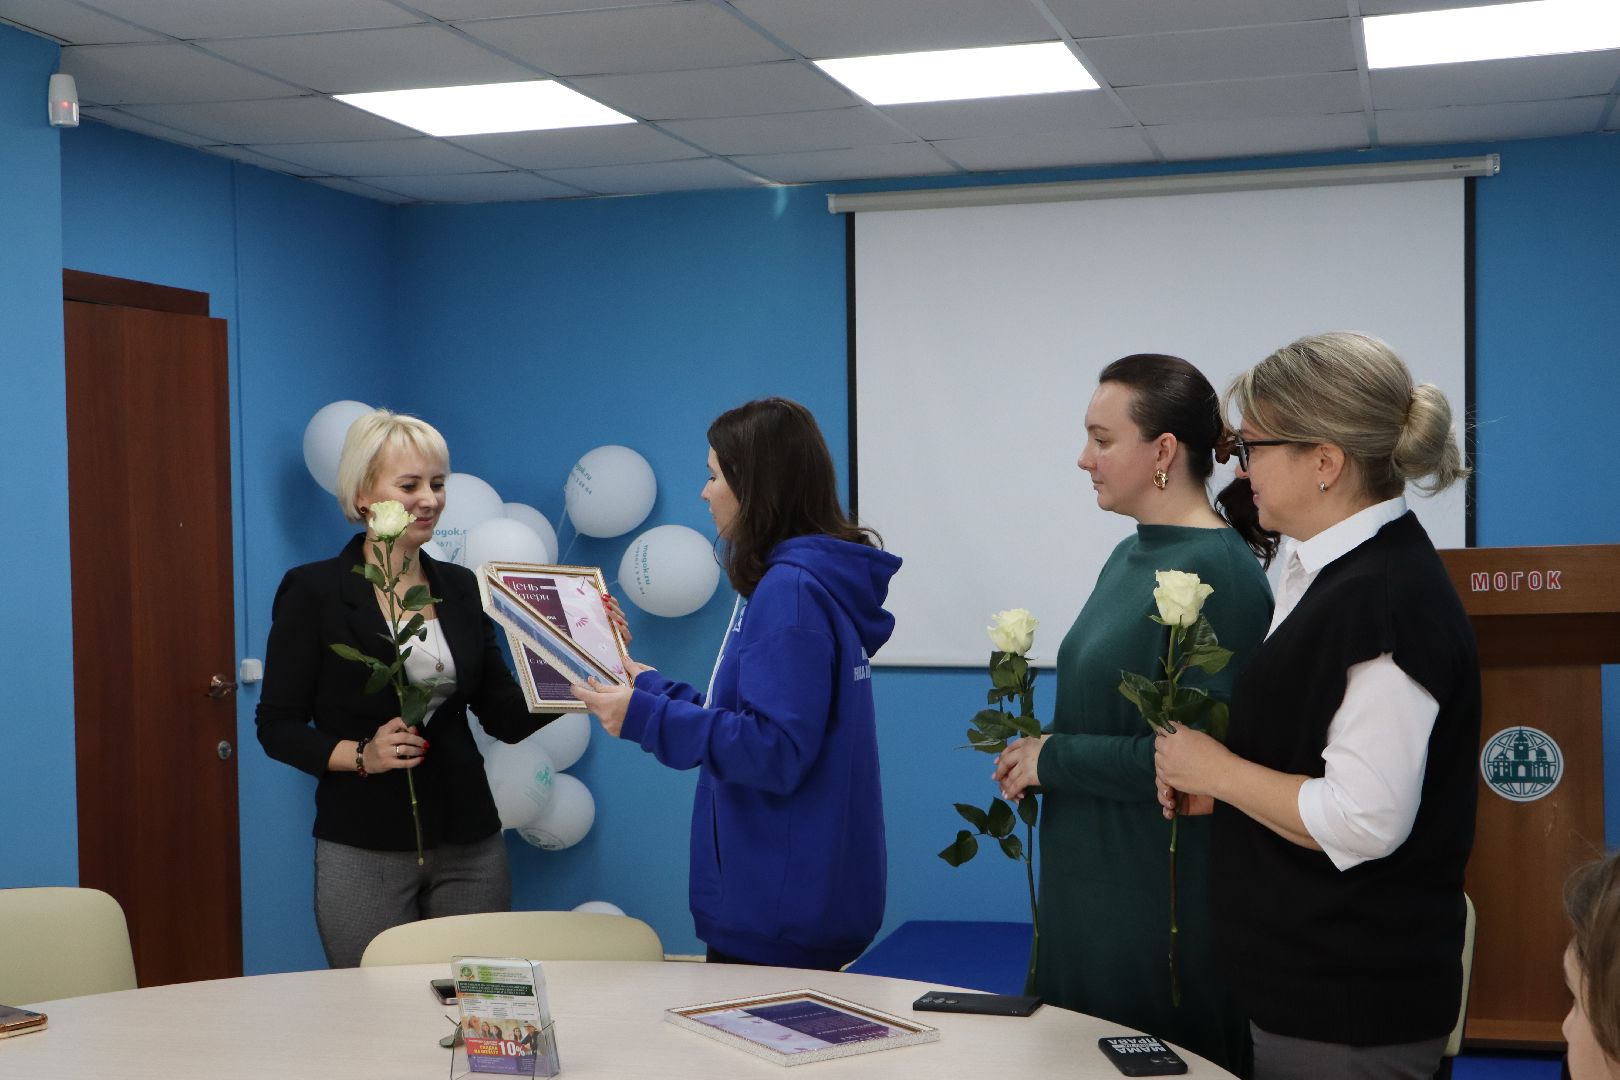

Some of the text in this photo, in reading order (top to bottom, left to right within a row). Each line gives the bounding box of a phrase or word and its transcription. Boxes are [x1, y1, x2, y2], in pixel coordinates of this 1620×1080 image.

[1471, 571, 1562, 592] МОГОК
[1107, 1037, 1157, 1045] ПРАВА
[498, 1041, 526, 1057] 10%
[1115, 1046, 1166, 1054] МАМА
